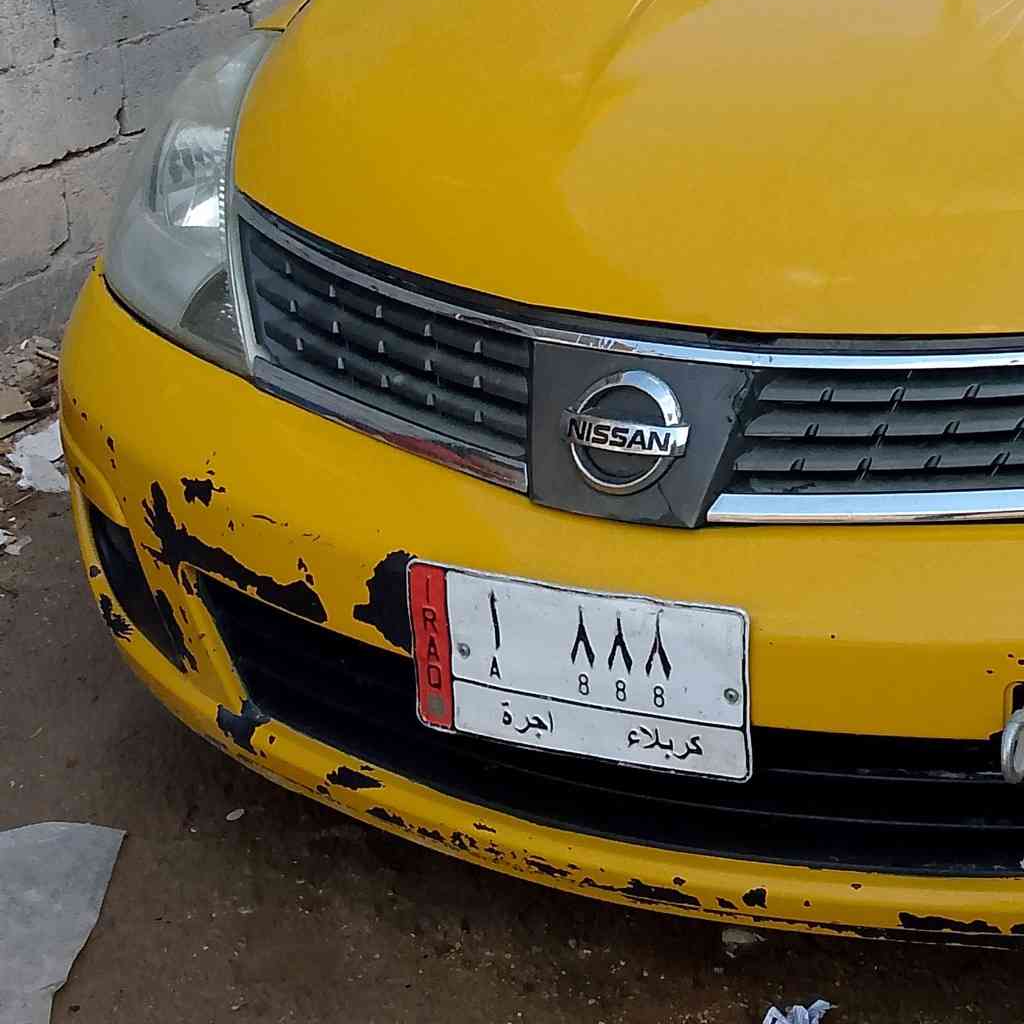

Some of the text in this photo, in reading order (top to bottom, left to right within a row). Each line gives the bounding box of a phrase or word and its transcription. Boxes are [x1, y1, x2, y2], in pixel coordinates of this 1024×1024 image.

[568, 418, 671, 452] NISSAN
[422, 575, 442, 690] IRAQ
[489, 656, 665, 708] A 888
[628, 725, 703, 760] كربلاء
